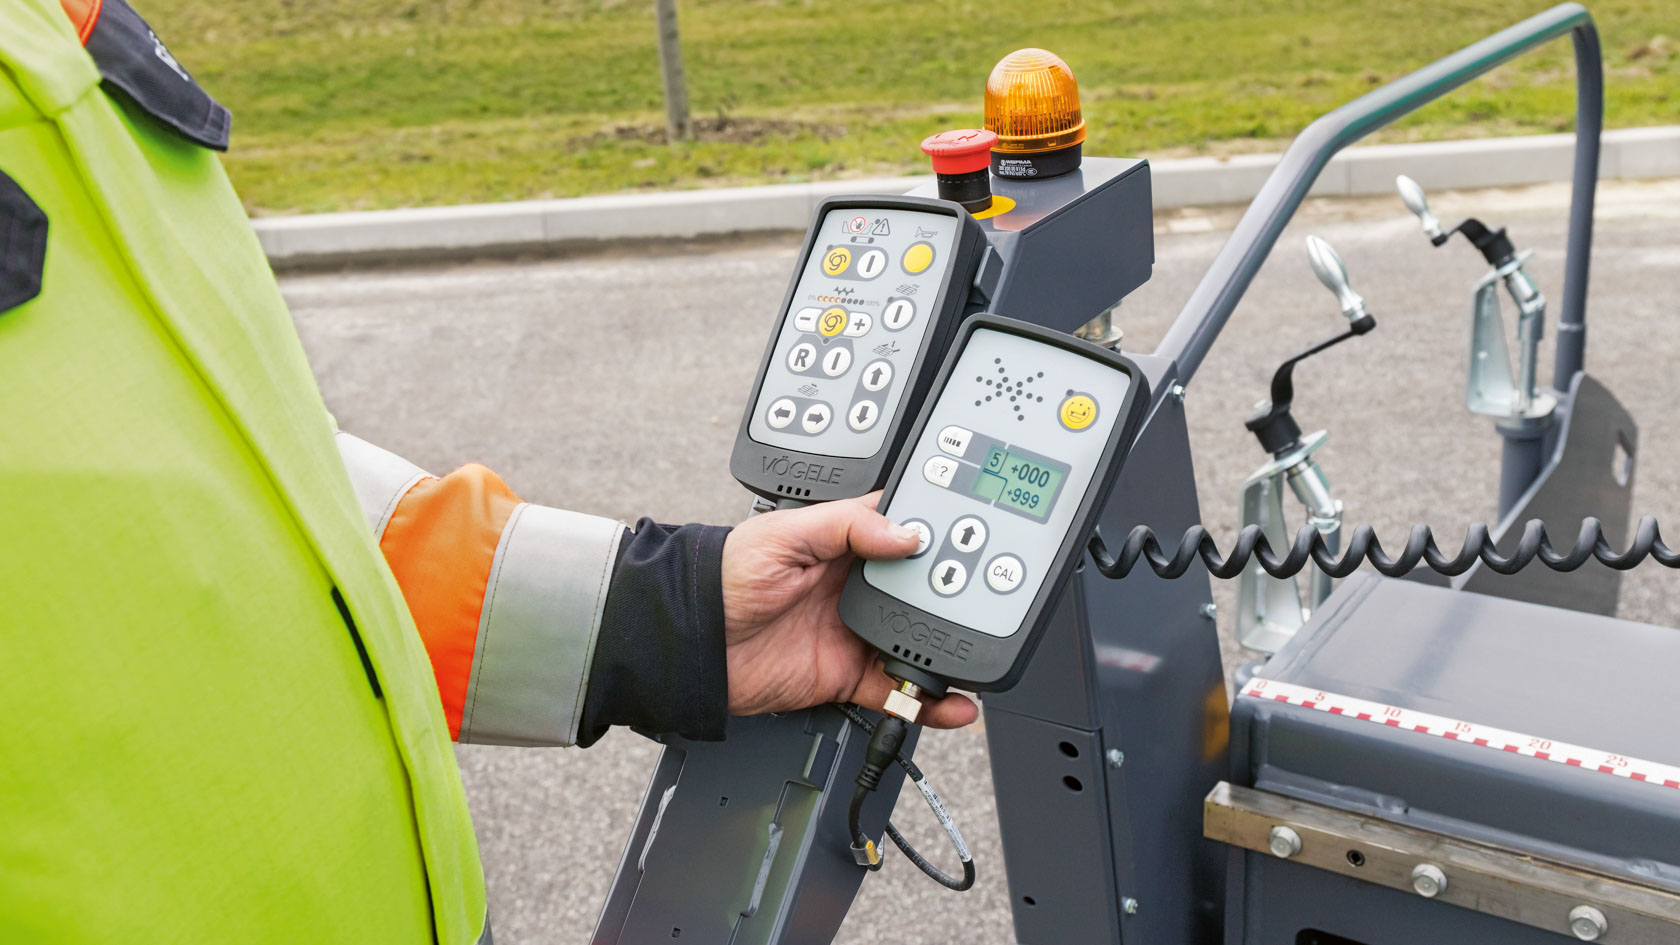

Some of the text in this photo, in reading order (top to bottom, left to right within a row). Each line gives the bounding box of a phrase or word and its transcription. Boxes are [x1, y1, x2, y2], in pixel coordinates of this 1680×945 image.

[794, 348, 809, 368] R
[761, 455, 845, 485] VÖGELE
[990, 452, 1001, 467] 5
[993, 565, 1014, 583] CAL
[877, 605, 974, 662] VÖGELE
[1255, 680, 1629, 768] 0 5 10 15 20 25
